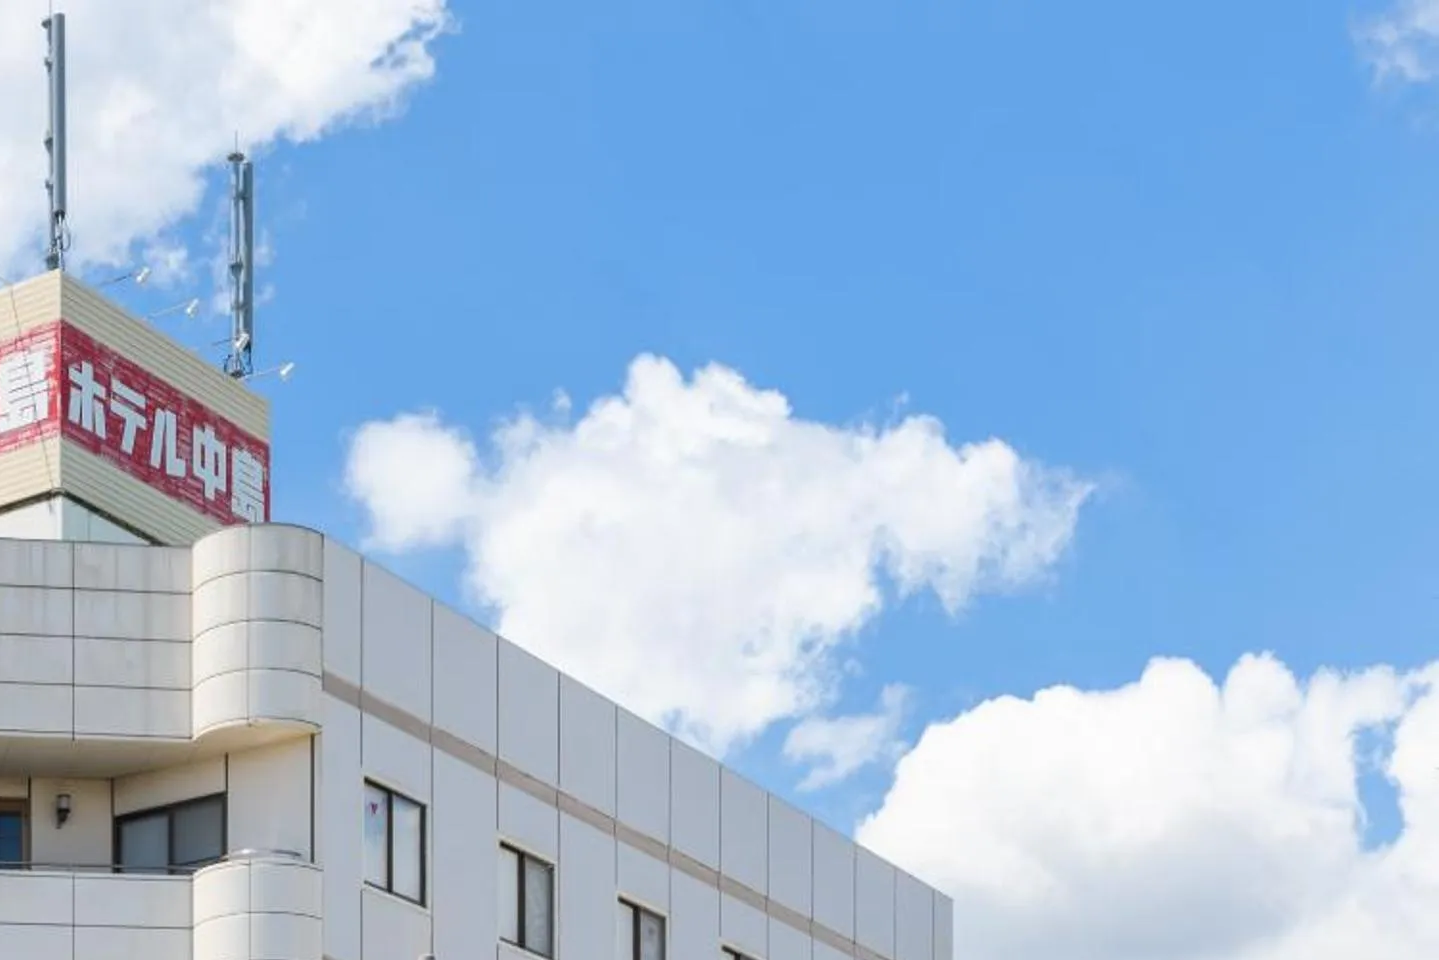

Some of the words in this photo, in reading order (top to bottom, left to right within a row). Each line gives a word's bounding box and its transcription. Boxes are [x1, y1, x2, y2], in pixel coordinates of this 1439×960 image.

[68, 361, 265, 523] ホテル中島
